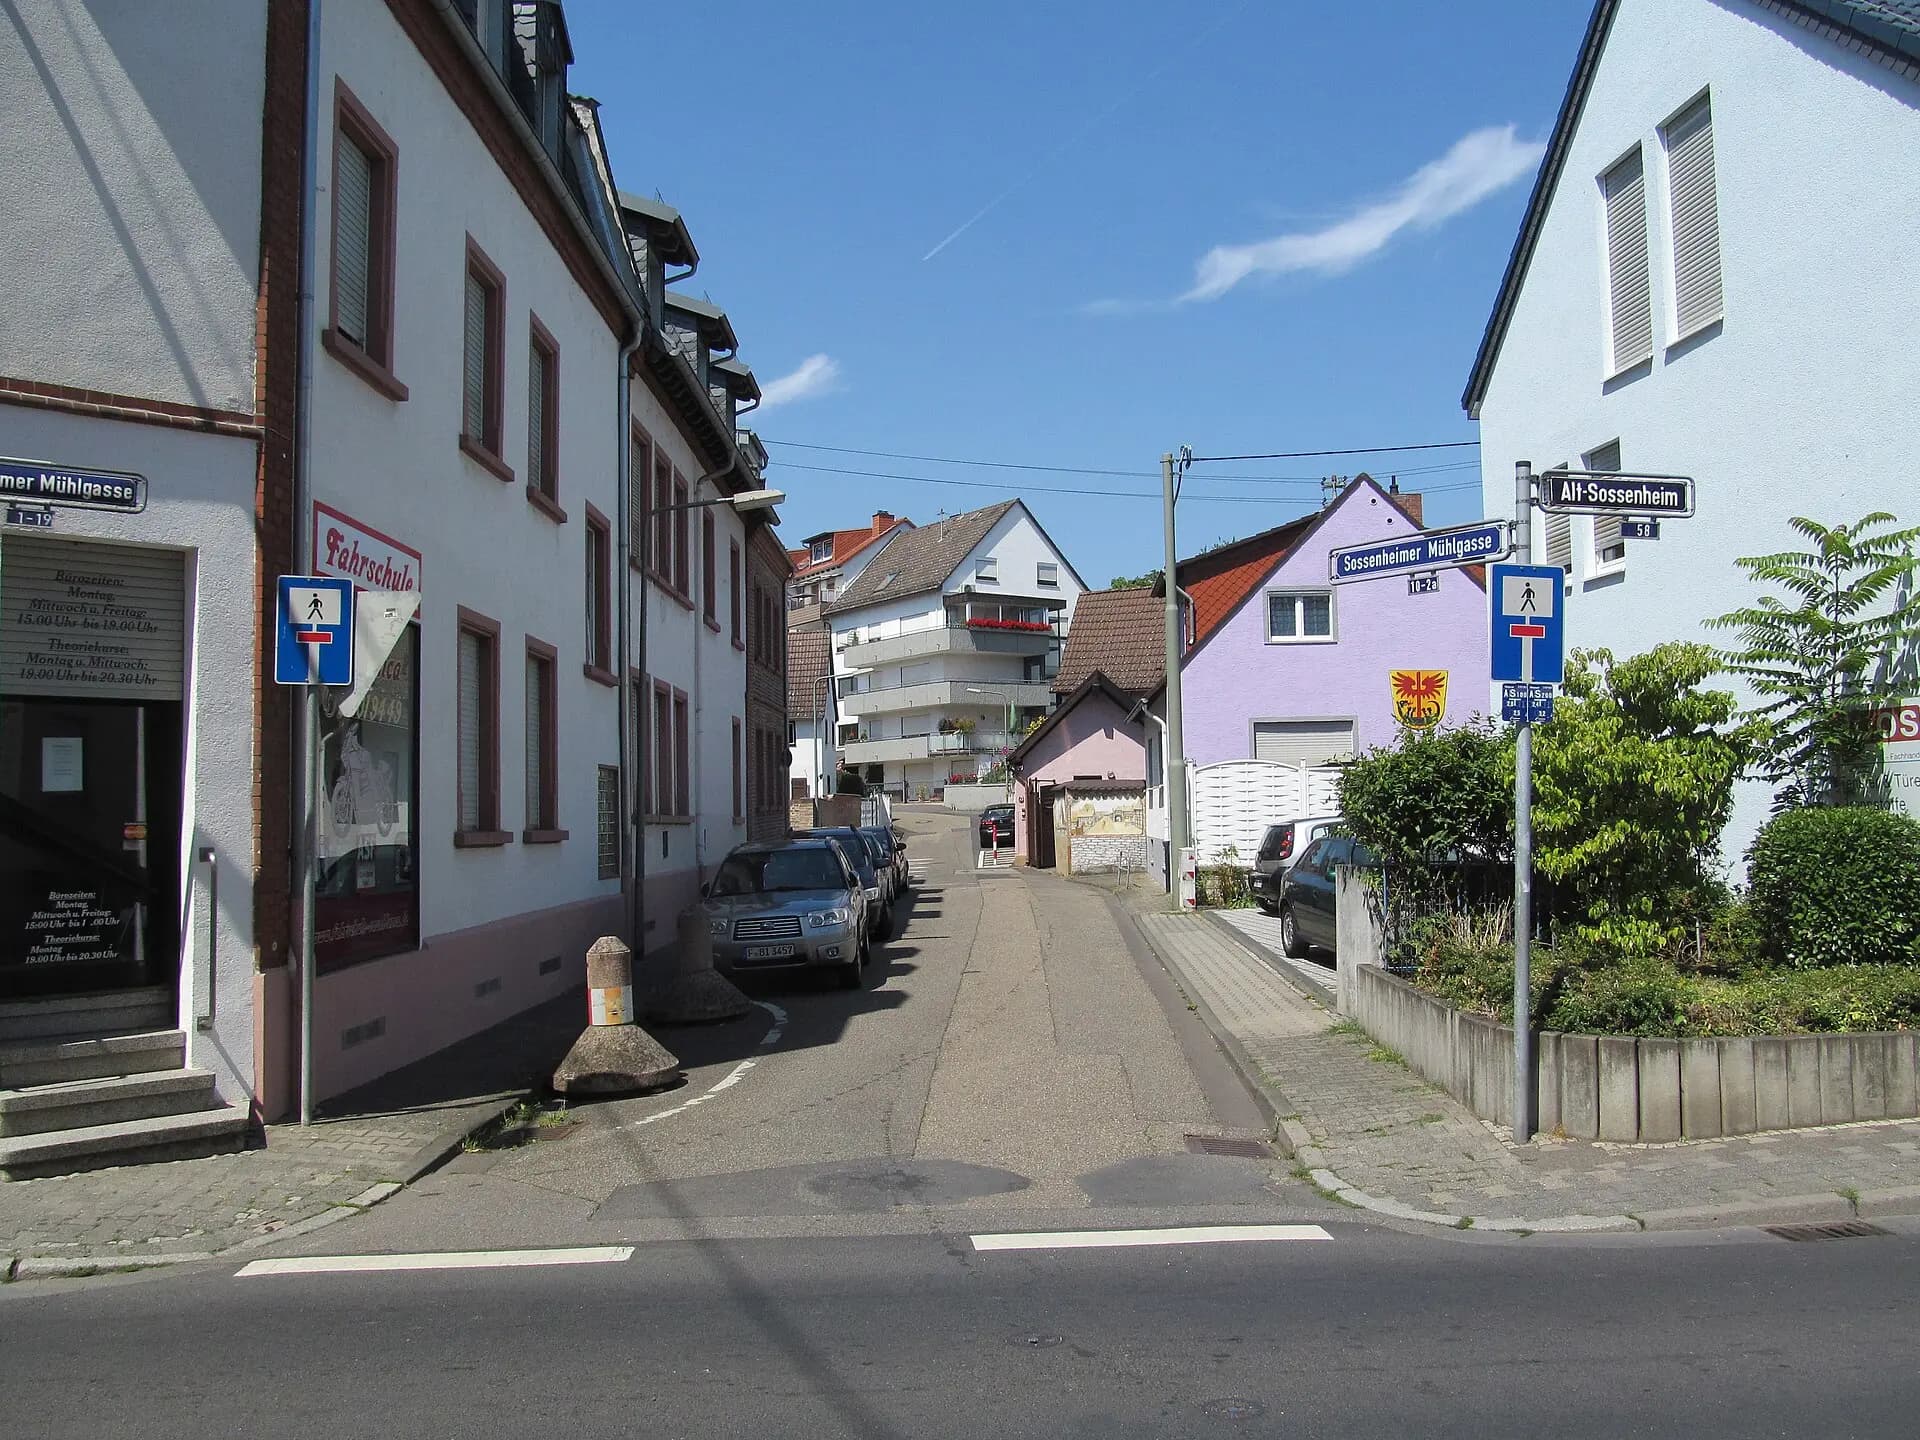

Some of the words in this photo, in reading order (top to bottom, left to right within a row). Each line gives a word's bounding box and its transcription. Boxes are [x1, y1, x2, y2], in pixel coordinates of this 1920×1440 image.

[40, 474, 133, 500] Mühlgasse
[1561, 481, 1678, 507] Alt-Sossenheim
[18, 512, 52, 526] 1-19
[1637, 524, 1650, 536] 58
[326, 528, 413, 592] Fahrschule
[1344, 547, 1422, 572] Sossenheimer
[1428, 536, 1492, 559] Mühlgasse
[55, 570, 124, 587] Bürozeiten:
[1410, 578, 1437, 593] 10-2a
[29, 599, 88, 613] Mittwoch
[102, 604, 147, 618] Freitag:
[17, 613, 52, 626] 15.00
[54, 615, 76, 627] Uhr
[83, 618, 99, 629] bis
[137, 621, 158, 633] Uhr
[48, 638, 129, 654] Theoriekurse:
[26, 652, 73, 668] Montag
[88, 656, 148, 670] Mittwoch:
[55, 669, 78, 682] Uhr
[80, 671, 98, 681] bis
[99, 672, 133, 683] 20.30
[135, 673, 157, 685] Uhr
[32, 911, 71, 919] Mittwoch
[49, 919, 66, 928] Uhr
[68, 919, 80, 928] bis
[105, 917, 120, 926] Uhr
[30, 945, 63, 954] Montag
[49, 953, 66, 962] Uhr
[66, 953, 78, 961] bis
[79, 951, 102, 960] 20.30
[103, 950, 120, 959] Uhr
